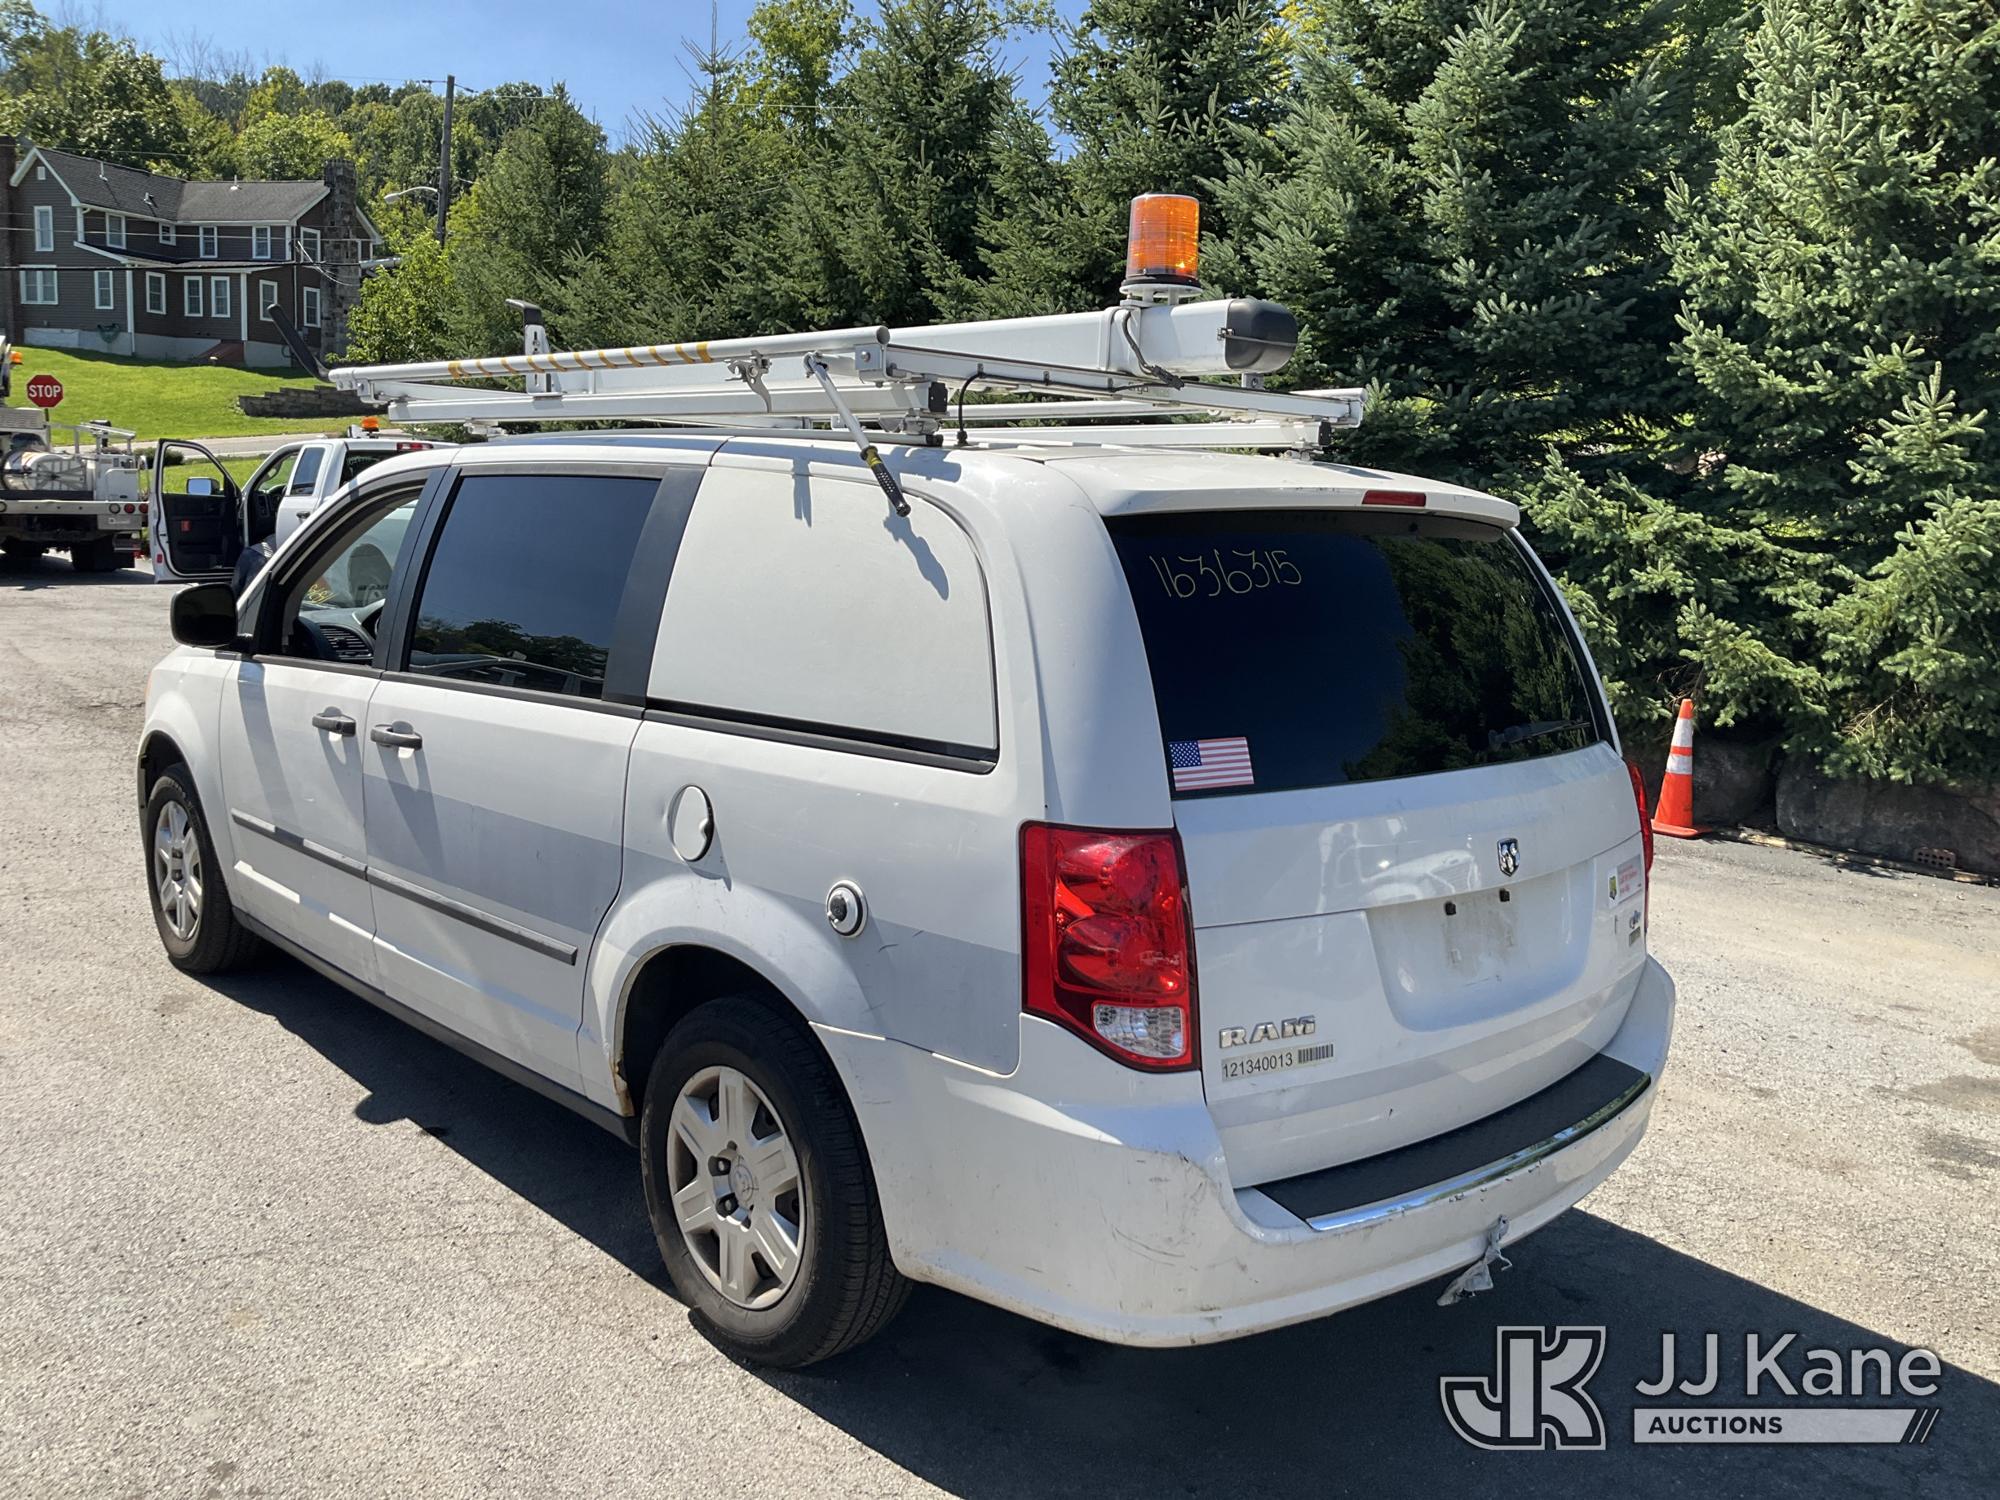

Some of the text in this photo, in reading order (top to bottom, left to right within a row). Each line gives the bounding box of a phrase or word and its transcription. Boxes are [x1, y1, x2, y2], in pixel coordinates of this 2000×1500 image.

[28, 384, 61, 398] STOP
[1149, 548, 1302, 599] 1636315
[1219, 1015, 1316, 1049] RAM
[1222, 1052, 1293, 1078] 121340013
